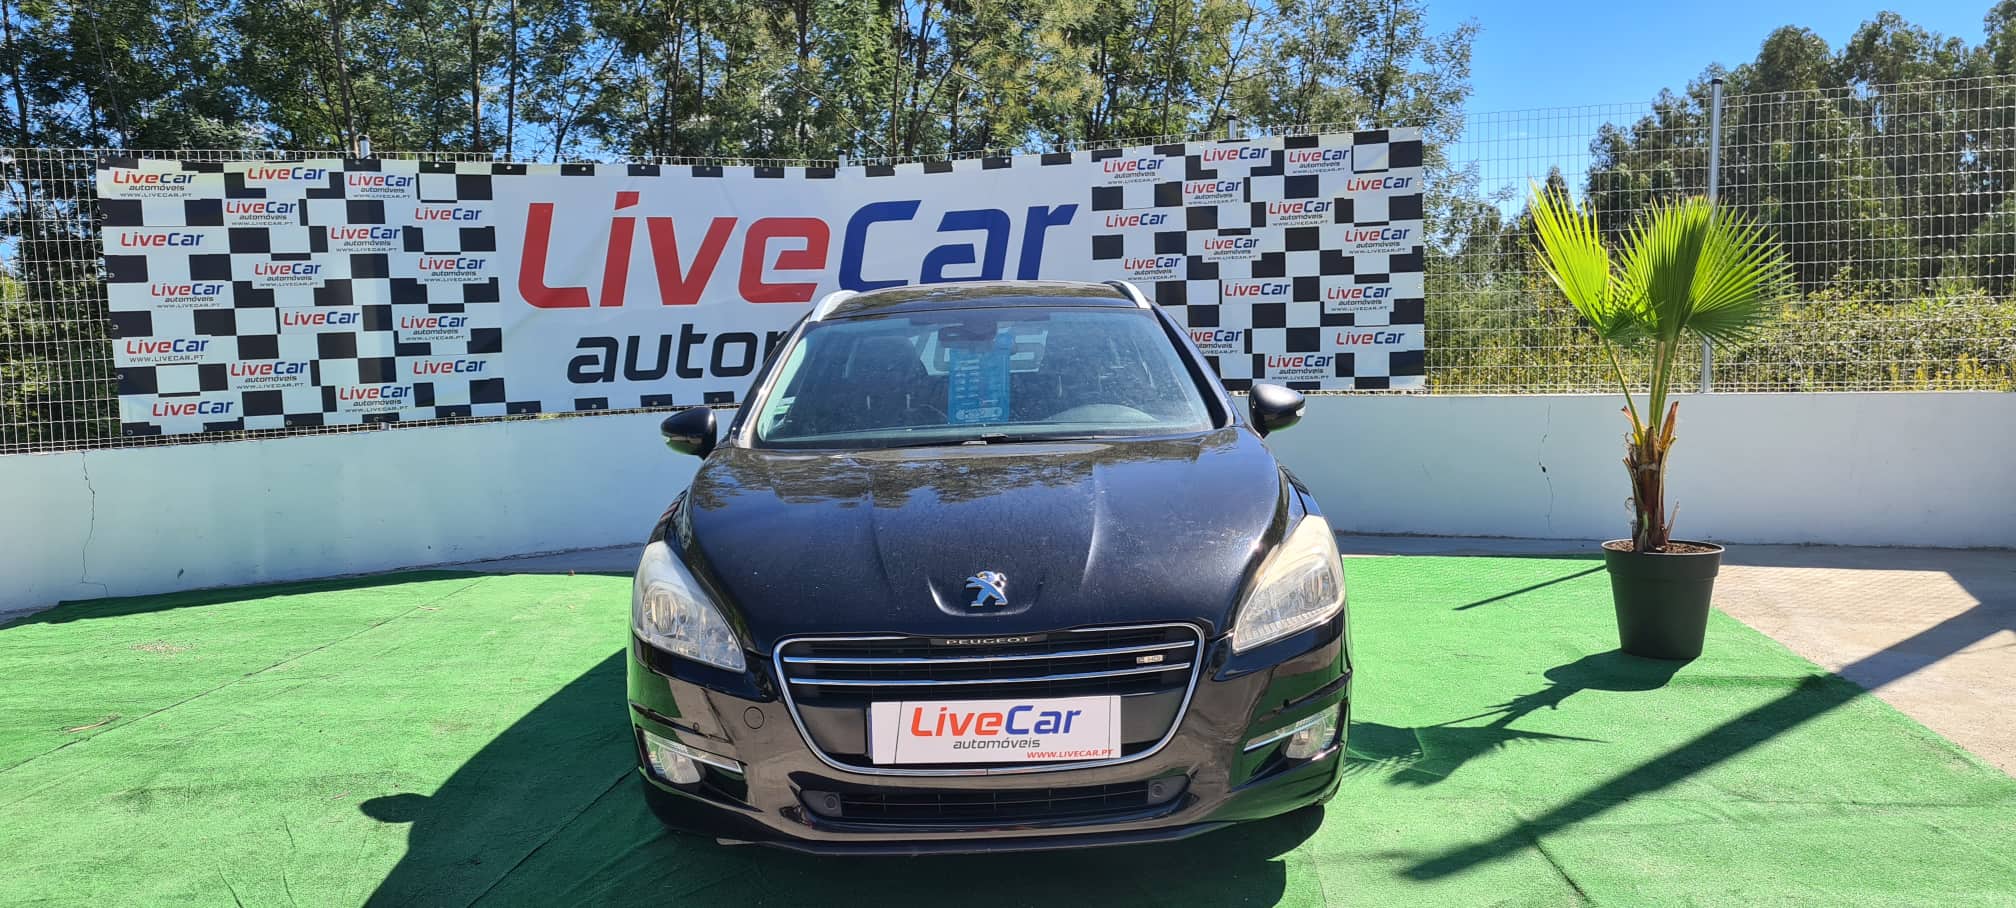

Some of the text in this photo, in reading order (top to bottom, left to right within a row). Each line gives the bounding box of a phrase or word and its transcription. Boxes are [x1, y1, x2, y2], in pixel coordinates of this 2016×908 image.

[1203, 147, 1269, 161] LiveCar
[1289, 150, 1349, 162] LiveCar
[1104, 159, 1164, 172] LiveCar
[113, 171, 197, 184] LiveCar
[248, 167, 326, 180] LiveCar
[349, 173, 414, 187] LiveCar
[129, 184, 184, 192] automóveis
[1185, 181, 1241, 193] LiveCar
[1347, 177, 1413, 191] LiveCar
[226, 201, 297, 213] LiveCar
[415, 207, 482, 220] LiveCar
[1269, 201, 1332, 214] LiveCar
[1106, 213, 1167, 227] LiveCar
[120, 232, 204, 246] LiveCar
[330, 226, 400, 239] LiveCar
[1345, 228, 1410, 242] LiveCar
[518, 191, 1079, 308] LiveCar
[1204, 238, 1259, 250] LiveCar
[254, 263, 322, 275] LiveCar
[419, 257, 486, 270] LiveCar
[1124, 257, 1181, 270] LiveCar
[151, 283, 224, 296] LiveCar
[1224, 283, 1291, 297] LiveCar
[1328, 286, 1392, 299] LiveCar
[165, 295, 214, 303] automóveis
[283, 311, 360, 325] LiveCar
[401, 315, 468, 328] LiveCar
[1190, 329, 1242, 342] iveCar
[1336, 332, 1405, 345] LiveCar
[126, 339, 209, 354] LiveCar
[1268, 353, 1333, 367] LiveCar
[231, 362, 308, 376] LiveCar
[413, 360, 486, 374] LiveCar
[340, 385, 412, 400] LiveCar
[153, 401, 234, 417] LiveCar
[946, 636, 1032, 644] PEUGEOT
[910, 704, 1081, 737] LiveCar
[953, 737, 1040, 749] automóveis
[1027, 749, 1114, 759] WWW.LIVECAR.PT
